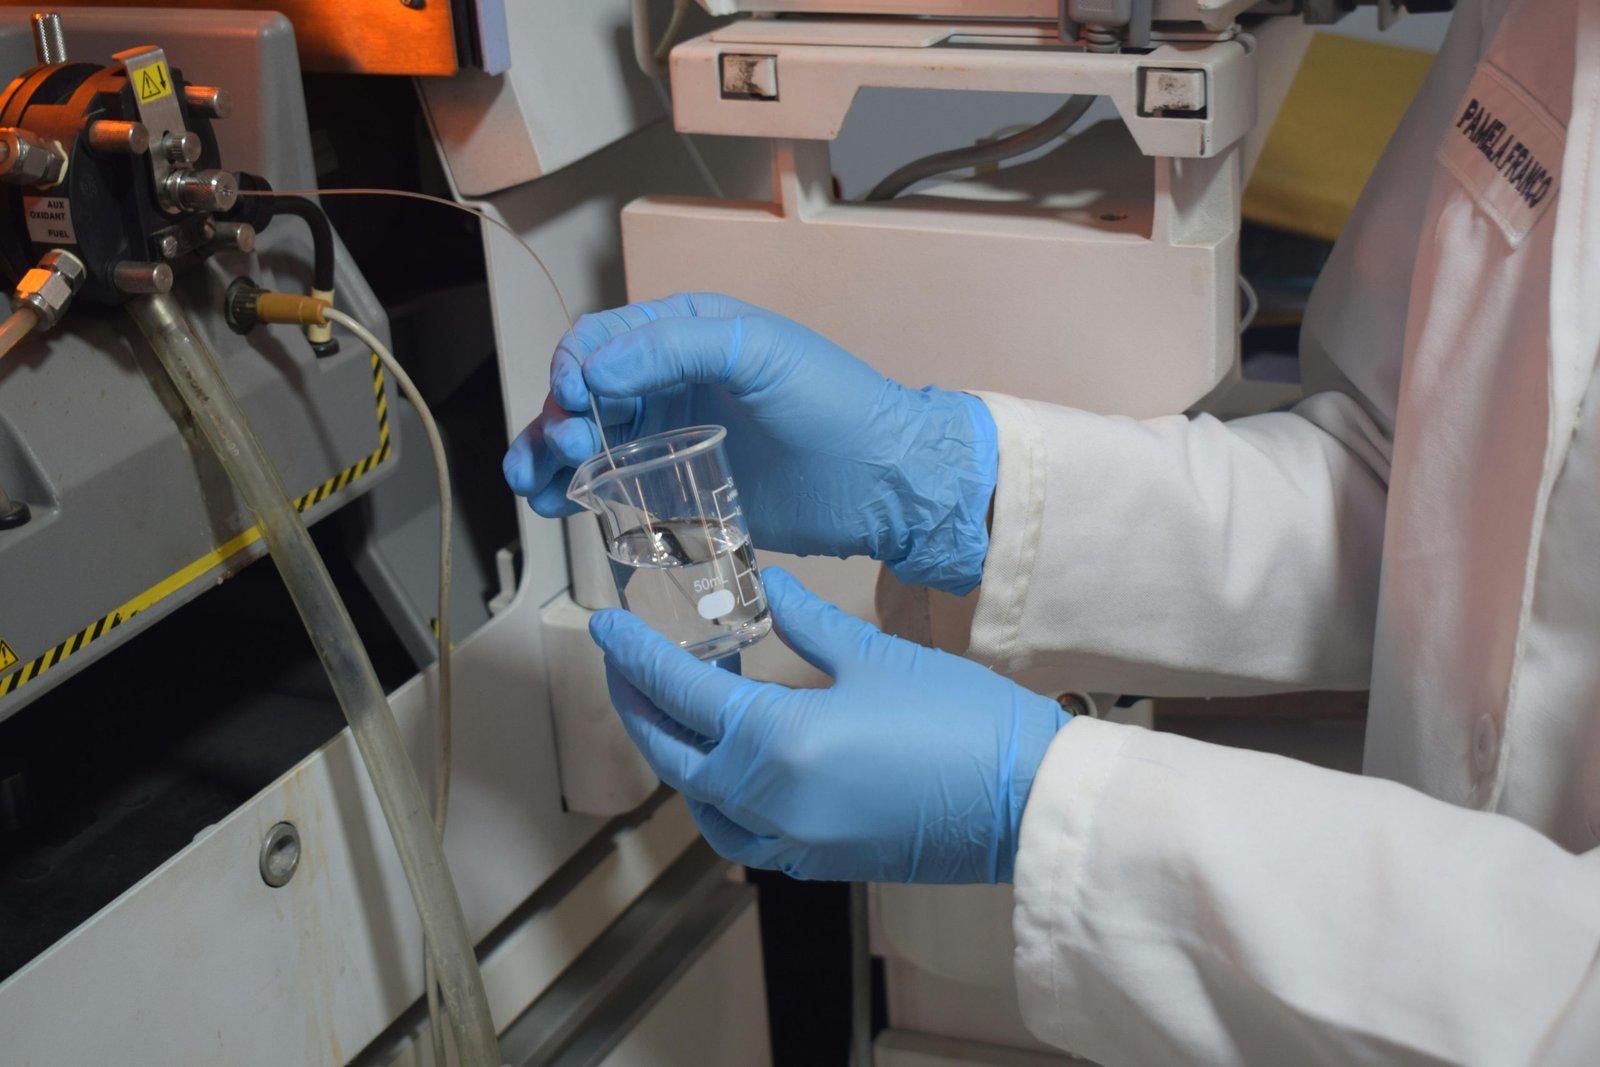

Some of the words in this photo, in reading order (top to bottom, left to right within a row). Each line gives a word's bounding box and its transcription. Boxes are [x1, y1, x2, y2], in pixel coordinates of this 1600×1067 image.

[1456, 98, 1514, 170] PAMELA
[1498, 142, 1553, 208] FRANCO
[47, 200, 65, 209] AUX
[30, 210, 65, 220] OXIDANT
[48, 229, 70, 238] FUEL
[693, 574, 729, 592] 50mL
